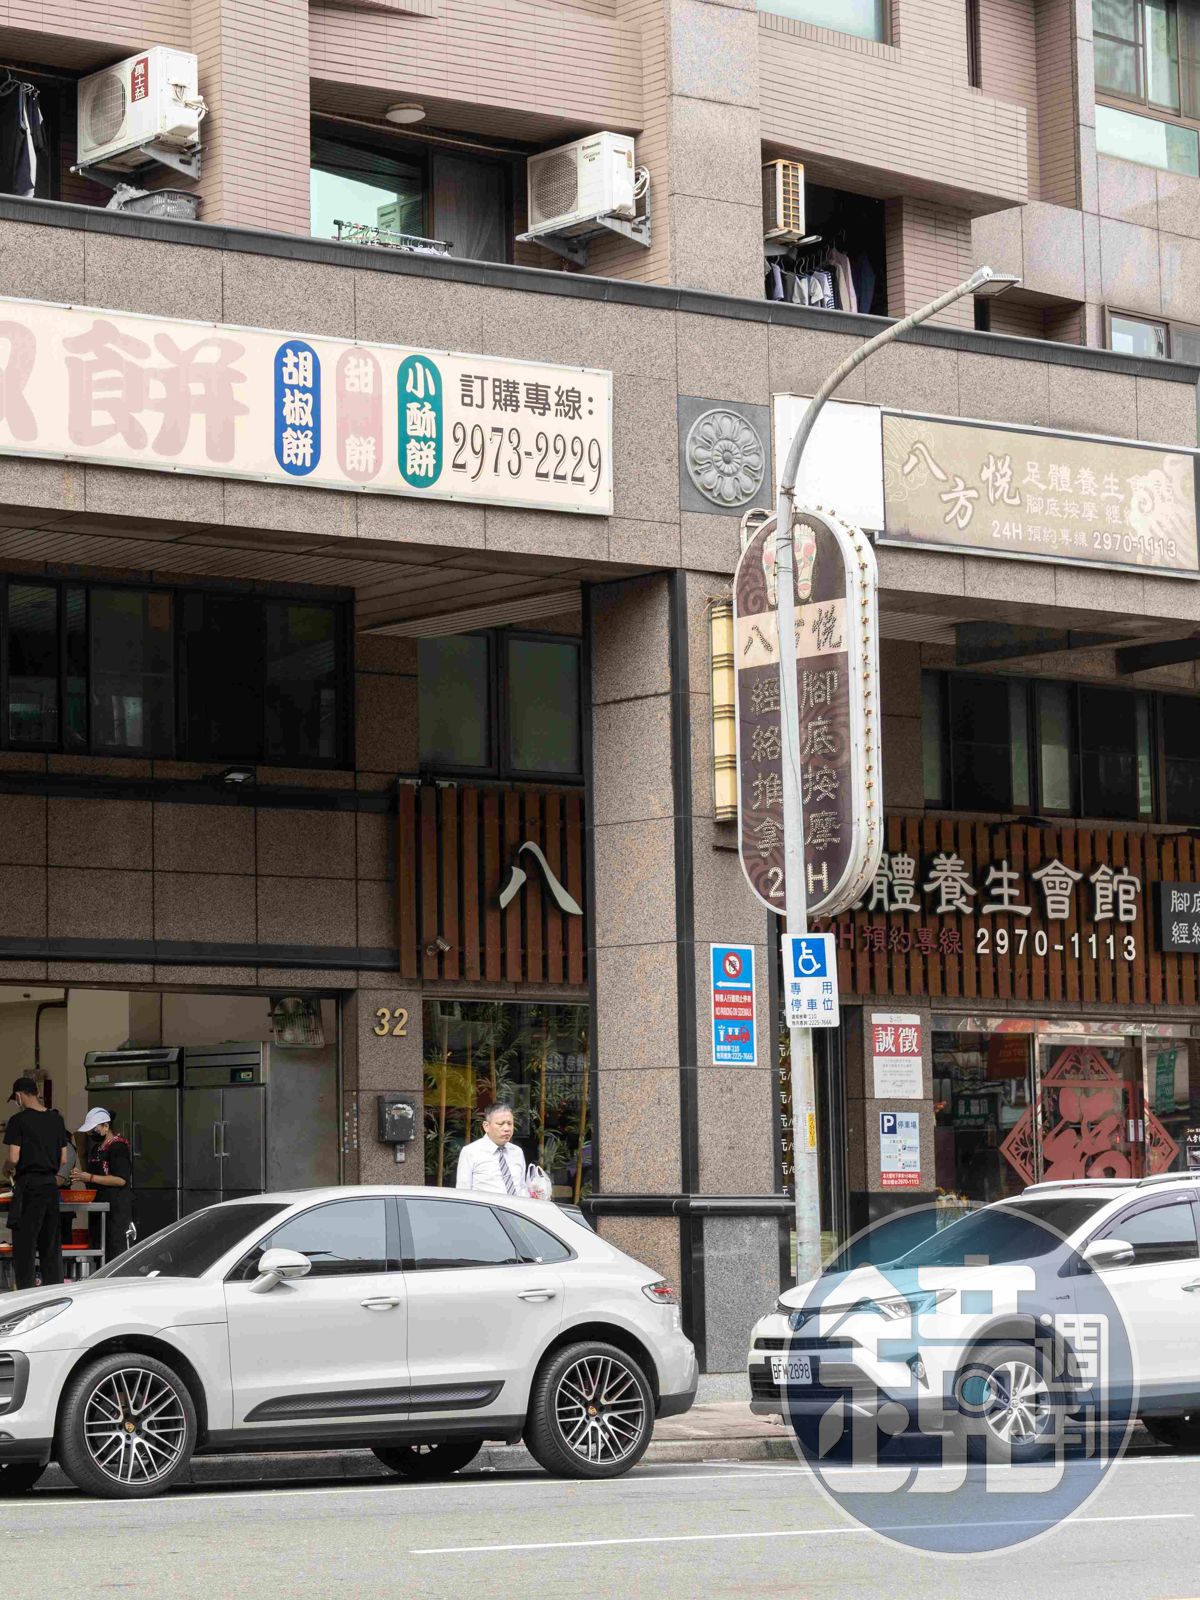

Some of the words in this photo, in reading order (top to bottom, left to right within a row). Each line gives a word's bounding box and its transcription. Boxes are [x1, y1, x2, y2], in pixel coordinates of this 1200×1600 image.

[281, 349, 314, 468] 胡椒餅
[344, 356, 377, 474] 甜餅
[459, 372, 595, 421] 訂購專線:
[451, 420, 602, 495] 2973-2229
[901, 440, 1022, 530] 八方悅
[1025, 494, 1100, 523] 腳底按摩
[991, 519, 1023, 541] 24H
[1092, 530, 1178, 558] 2970-1113
[801, 670, 841, 851] 腳底按摩
[499, 841, 584, 910] 八
[851, 853, 1142, 923] 體養生會館
[976, 927, 1137, 961] 2970-1113
[790, 981, 833, 995] 專用
[791, 998, 834, 1012] 停車位
[374, 1007, 409, 1037] 32
[875, 1026, 919, 1054] 誠徵
[897, 1120, 917, 1130] 停車場
